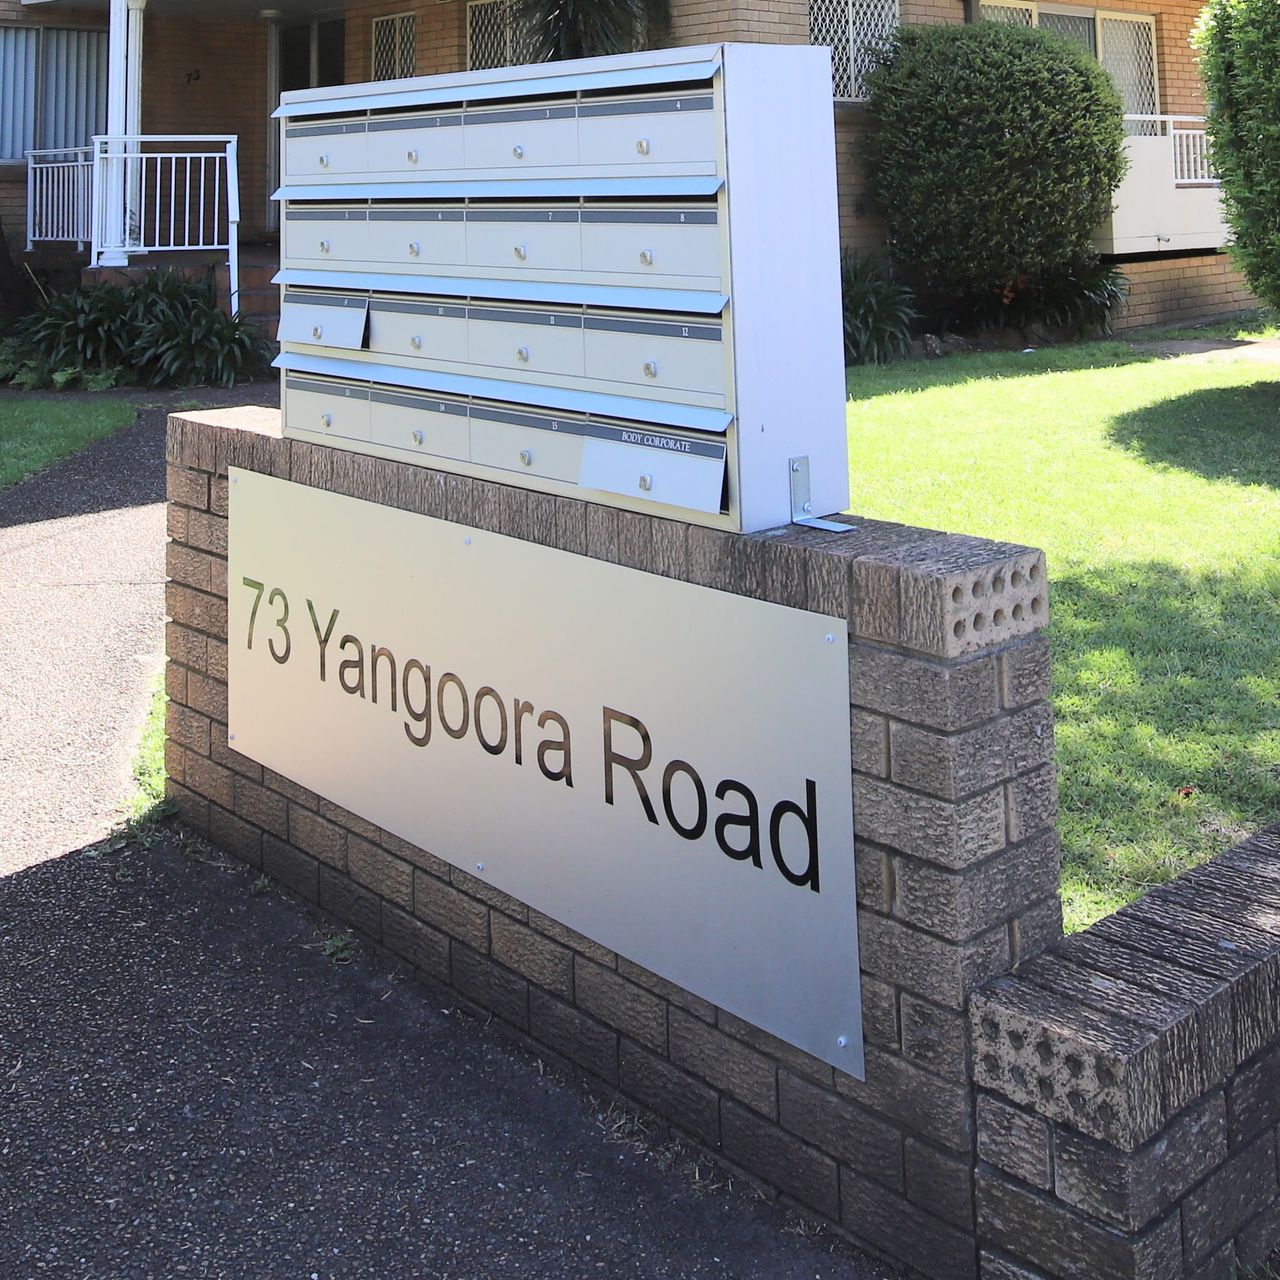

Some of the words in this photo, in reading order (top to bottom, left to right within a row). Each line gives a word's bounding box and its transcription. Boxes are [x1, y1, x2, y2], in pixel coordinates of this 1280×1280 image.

[676, 100, 681, 110] 4
[546, 109, 550, 118] 3
[548, 212, 552, 221] 7
[680, 212, 685, 222] 8
[550, 315, 555, 324] 11
[682, 327, 689, 336] 12
[439, 403, 445, 411] 14
[552, 420, 558, 430] 15
[621, 431, 643, 443] BODY
[644, 436, 691, 452] CORPORATE
[242, 577, 291, 664] 73
[306, 599, 574, 789] Yangoora
[602, 706, 821, 893] Road
